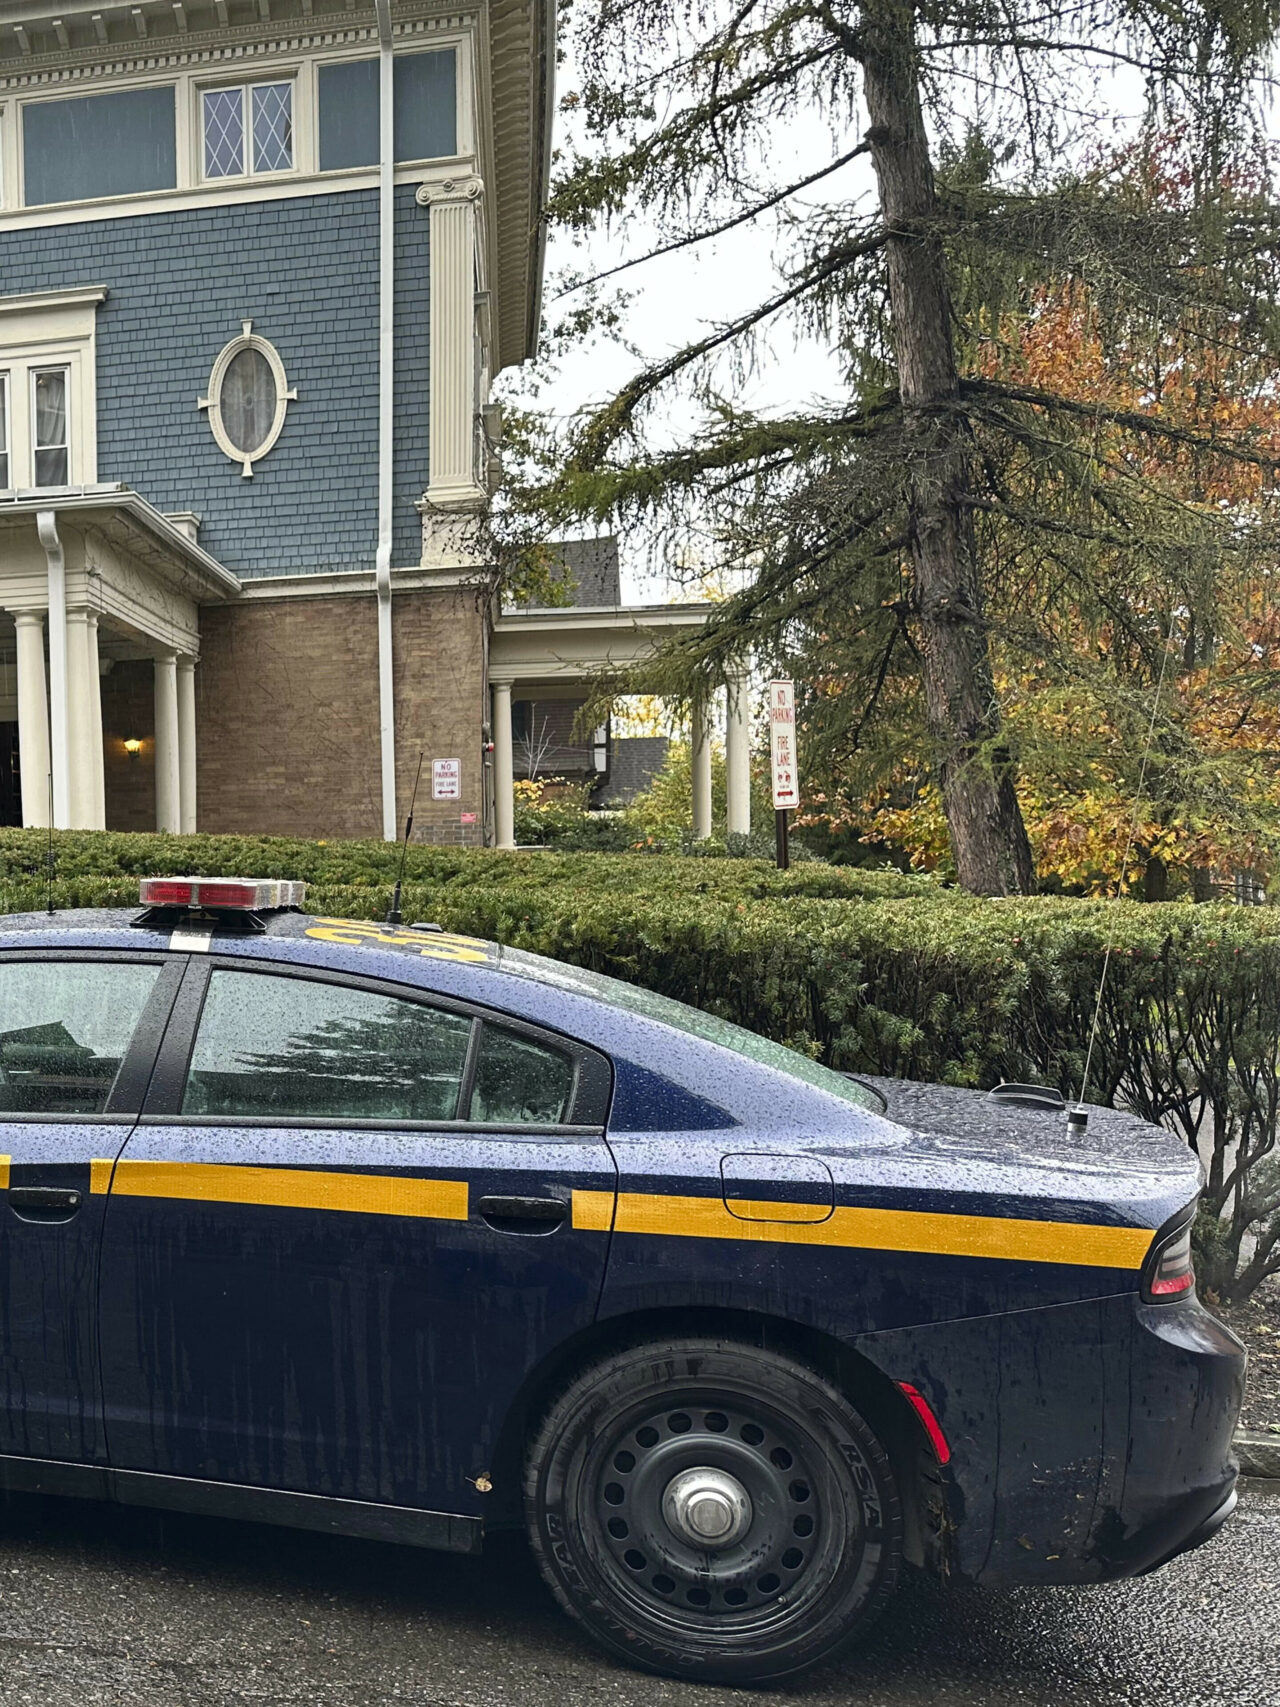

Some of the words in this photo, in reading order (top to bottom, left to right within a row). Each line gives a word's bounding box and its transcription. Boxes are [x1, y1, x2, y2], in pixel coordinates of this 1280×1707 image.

[777, 690, 786, 706] NO
[772, 707, 793, 723] PARKING
[777, 735, 789, 750] FIRE
[440, 763, 452, 771] NO
[777, 752, 791, 767] LANE
